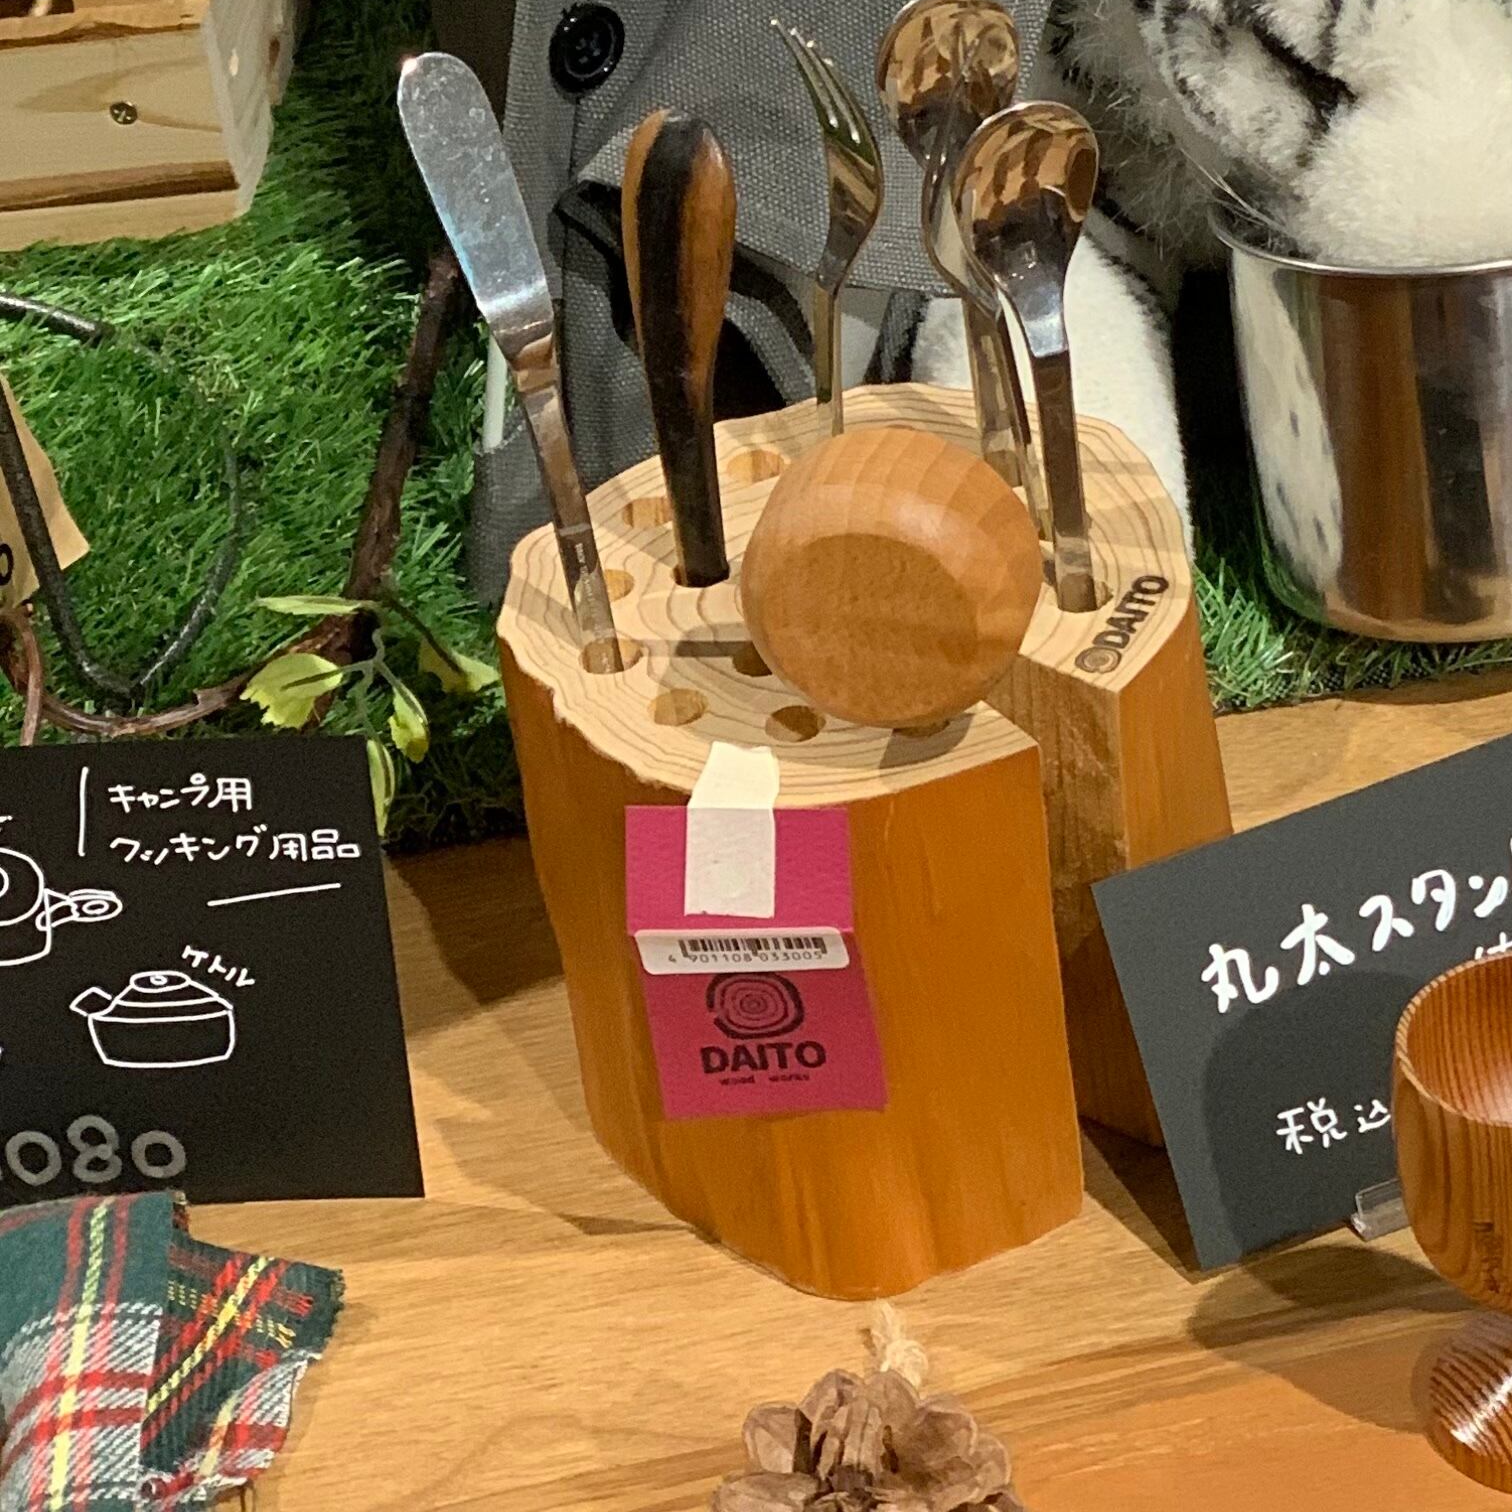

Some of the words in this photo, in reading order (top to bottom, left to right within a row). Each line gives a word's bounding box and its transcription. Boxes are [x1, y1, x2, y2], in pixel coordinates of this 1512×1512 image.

[1092, 575, 1170, 648] DAITO
[107, 773, 253, 813] キャンプ用
[110, 825, 361, 865] クッキング用品
[181, 945, 256, 987] ケトル
[701, 1040, 826, 1074] DAITO
[1276, 1097, 1391, 1155] 税込
[0, 1115, 187, 1186] 080
